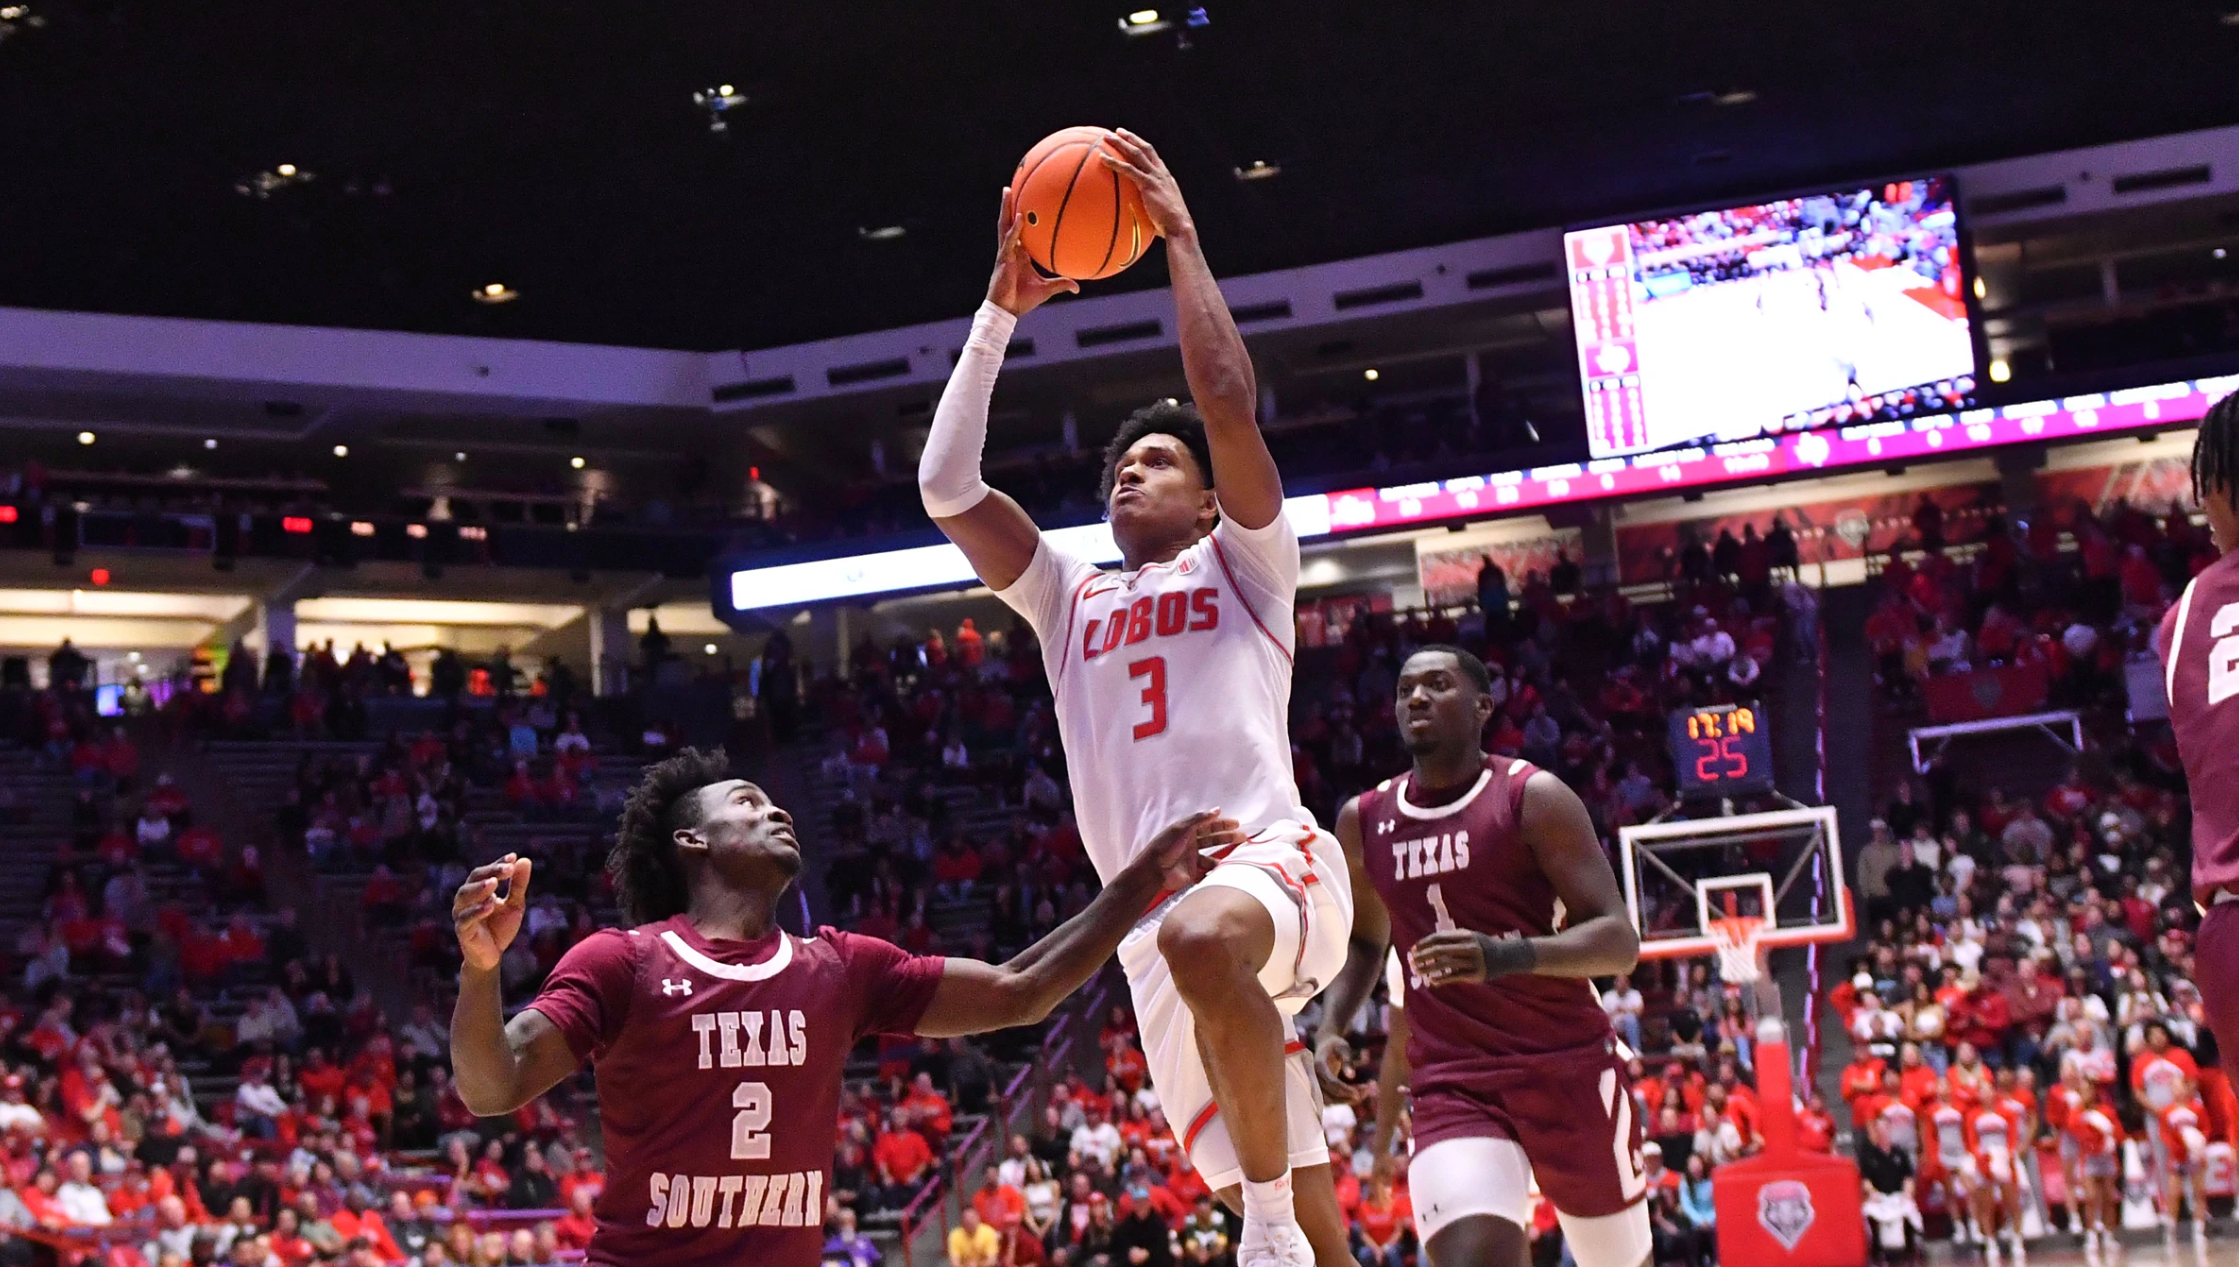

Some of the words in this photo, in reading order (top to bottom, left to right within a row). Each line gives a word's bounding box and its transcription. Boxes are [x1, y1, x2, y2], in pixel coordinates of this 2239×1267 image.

[1083, 587, 1219, 662] LOBOS
[1128, 656, 1168, 741] 3
[1697, 735, 1747, 781] 25
[1392, 829, 1470, 881] TEXAS
[1426, 883, 1457, 932] 1
[691, 1009, 806, 1069] TEXAS
[730, 1081, 772, 1160] 2
[645, 1169, 824, 1229] SOUTHERN
